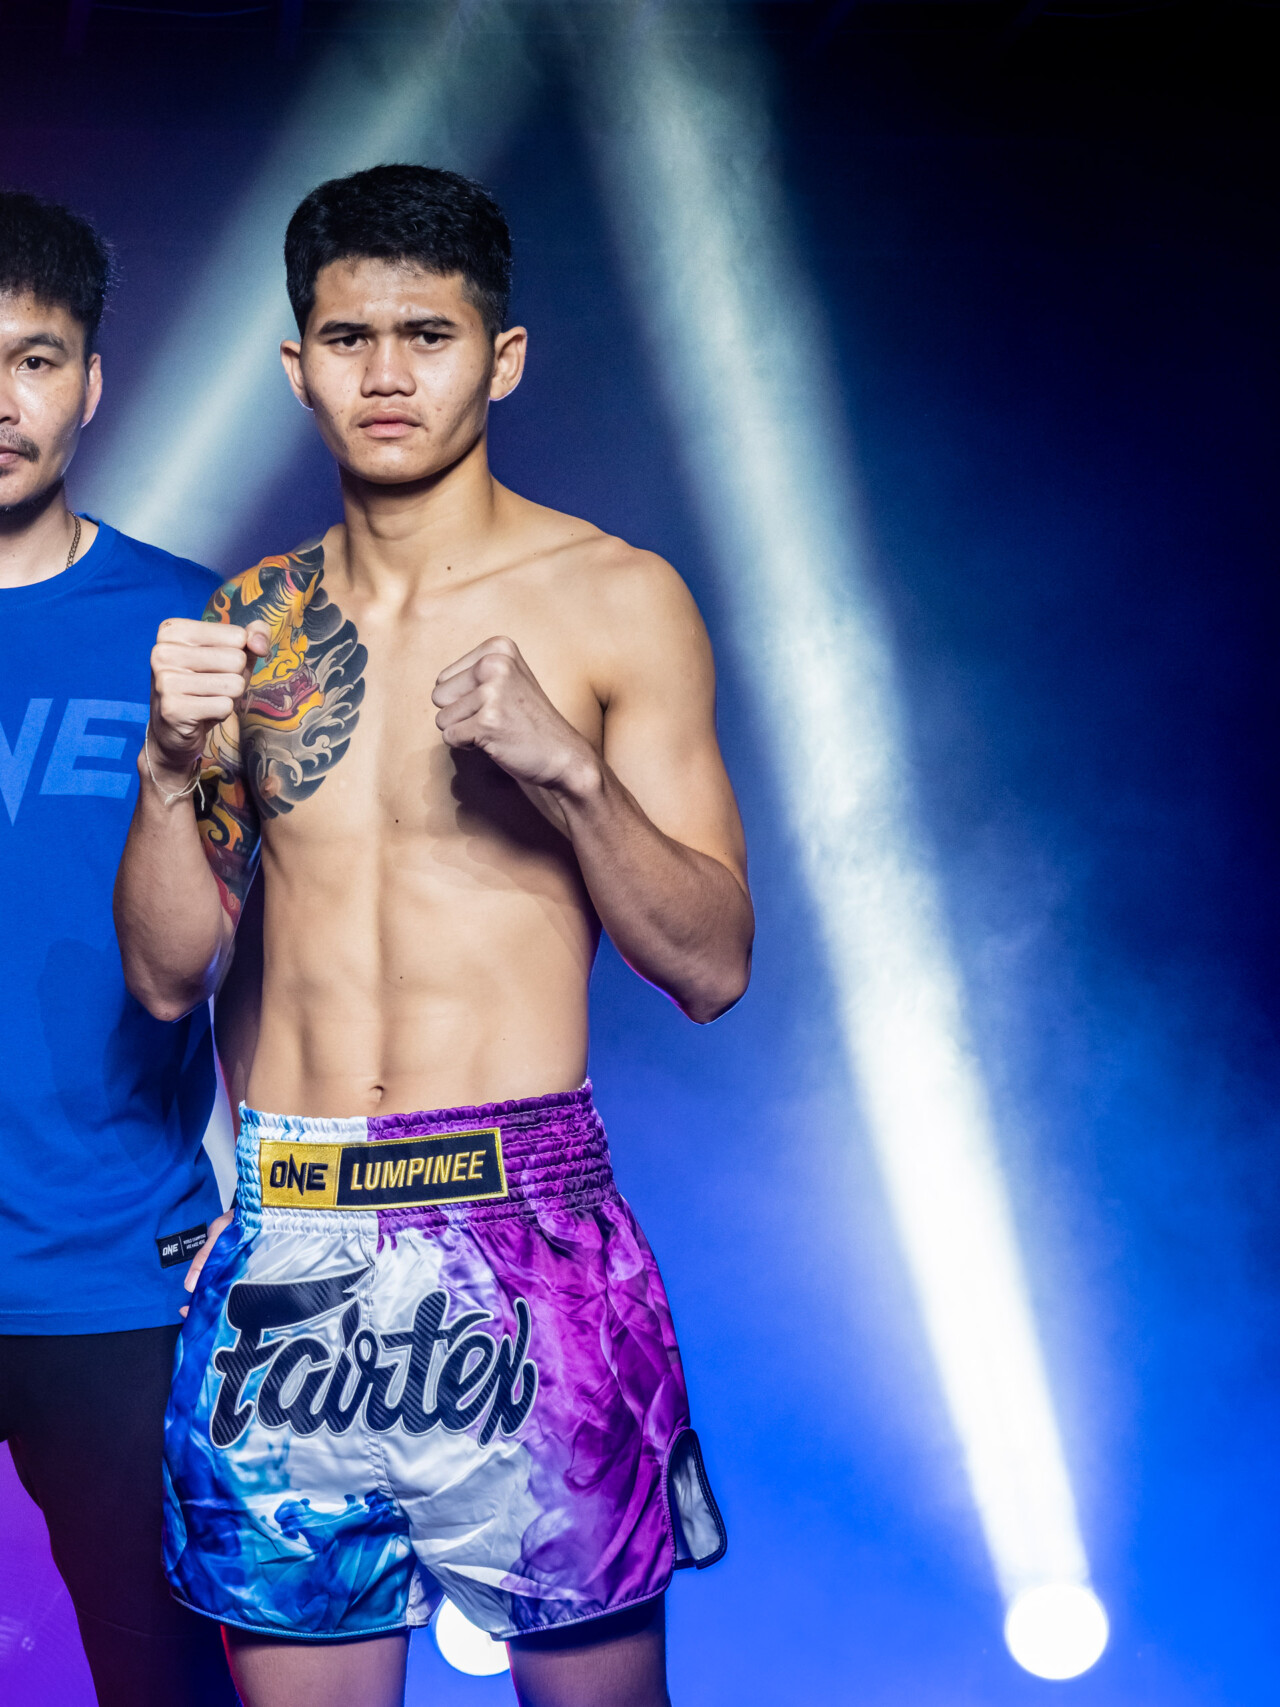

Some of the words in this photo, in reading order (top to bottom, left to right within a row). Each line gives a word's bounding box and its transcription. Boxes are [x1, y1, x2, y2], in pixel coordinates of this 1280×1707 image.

[270, 1153, 328, 1195] ONE
[350, 1150, 487, 1190] LUMPINEE
[162, 1244, 179, 1256] ONE
[210, 1266, 539, 1449] Fairtex
